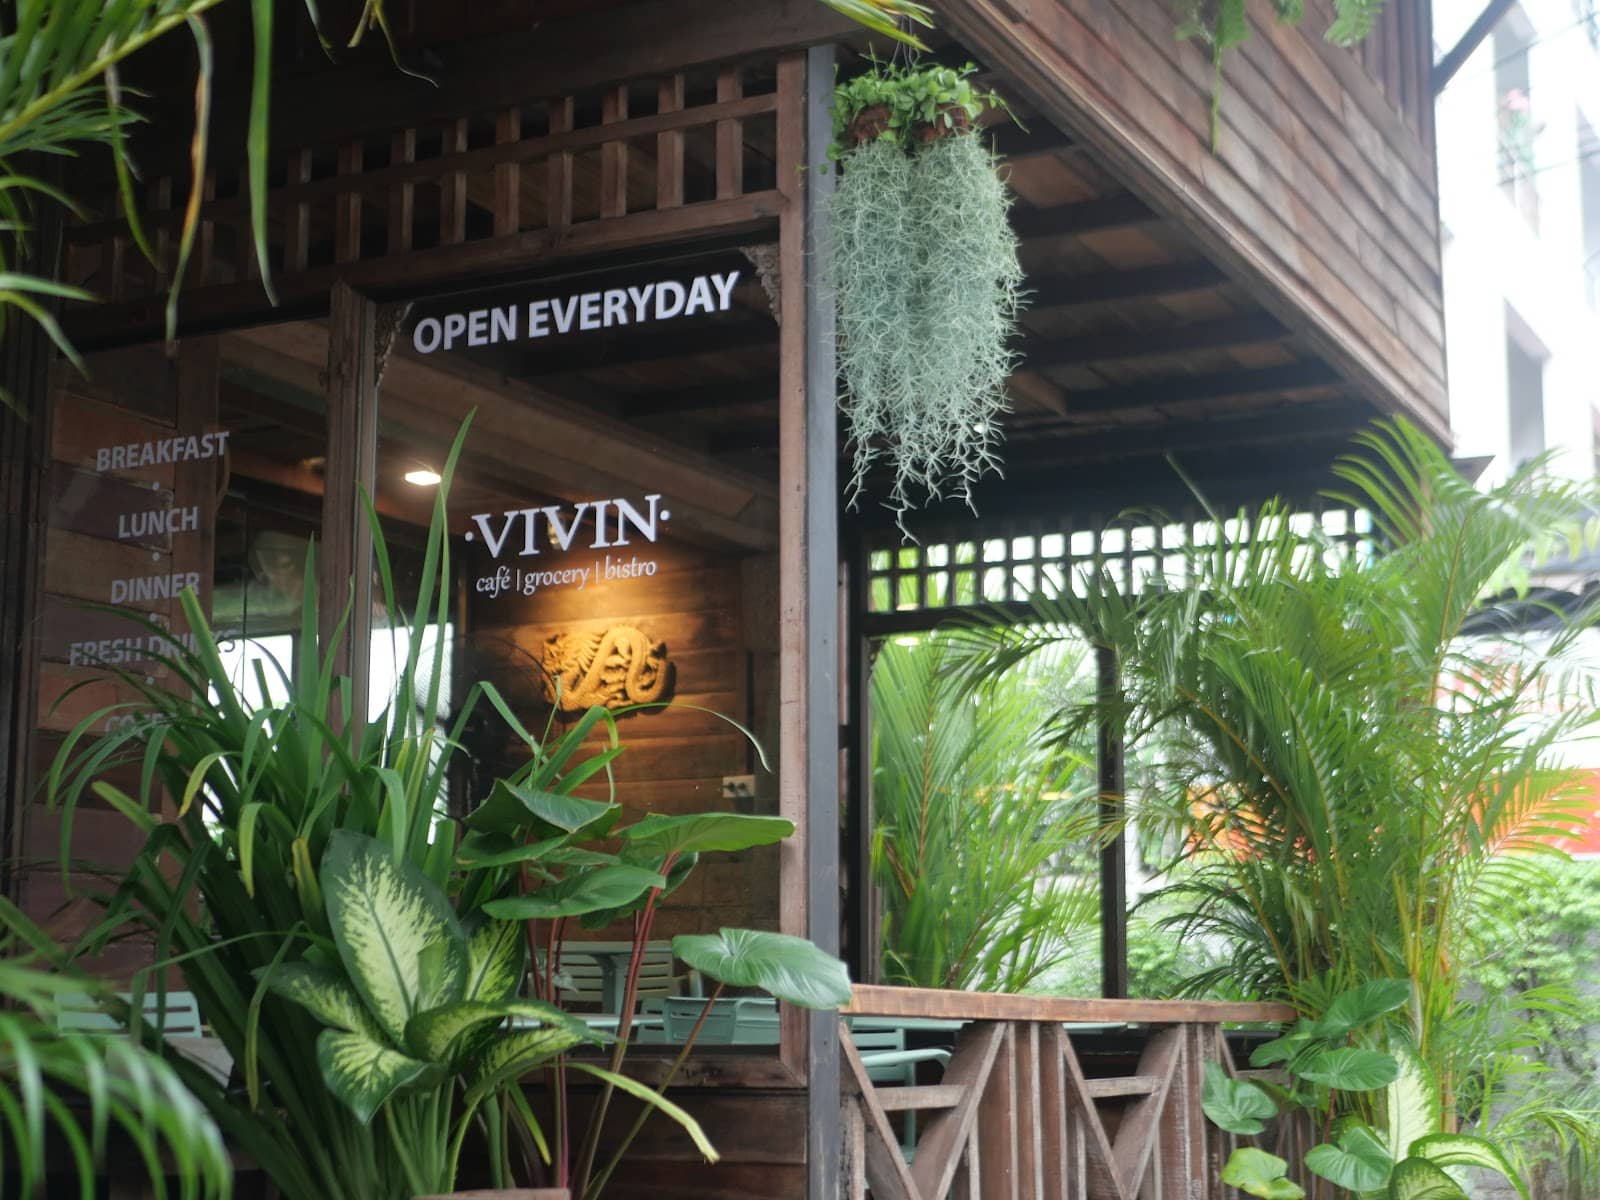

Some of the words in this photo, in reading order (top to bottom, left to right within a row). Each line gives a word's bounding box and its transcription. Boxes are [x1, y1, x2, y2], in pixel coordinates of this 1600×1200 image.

[412, 304, 519, 354] OPEN
[527, 270, 741, 339] EVERYDAY
[96, 431, 230, 472] BREAKFAST
[117, 506, 199, 539] LUNCH
[110, 571, 201, 605] DINNER
[475, 564, 511, 599] café
[522, 566, 591, 596] grocery
[604, 554, 658, 581] bistro
[69, 637, 142, 669] FRESH
